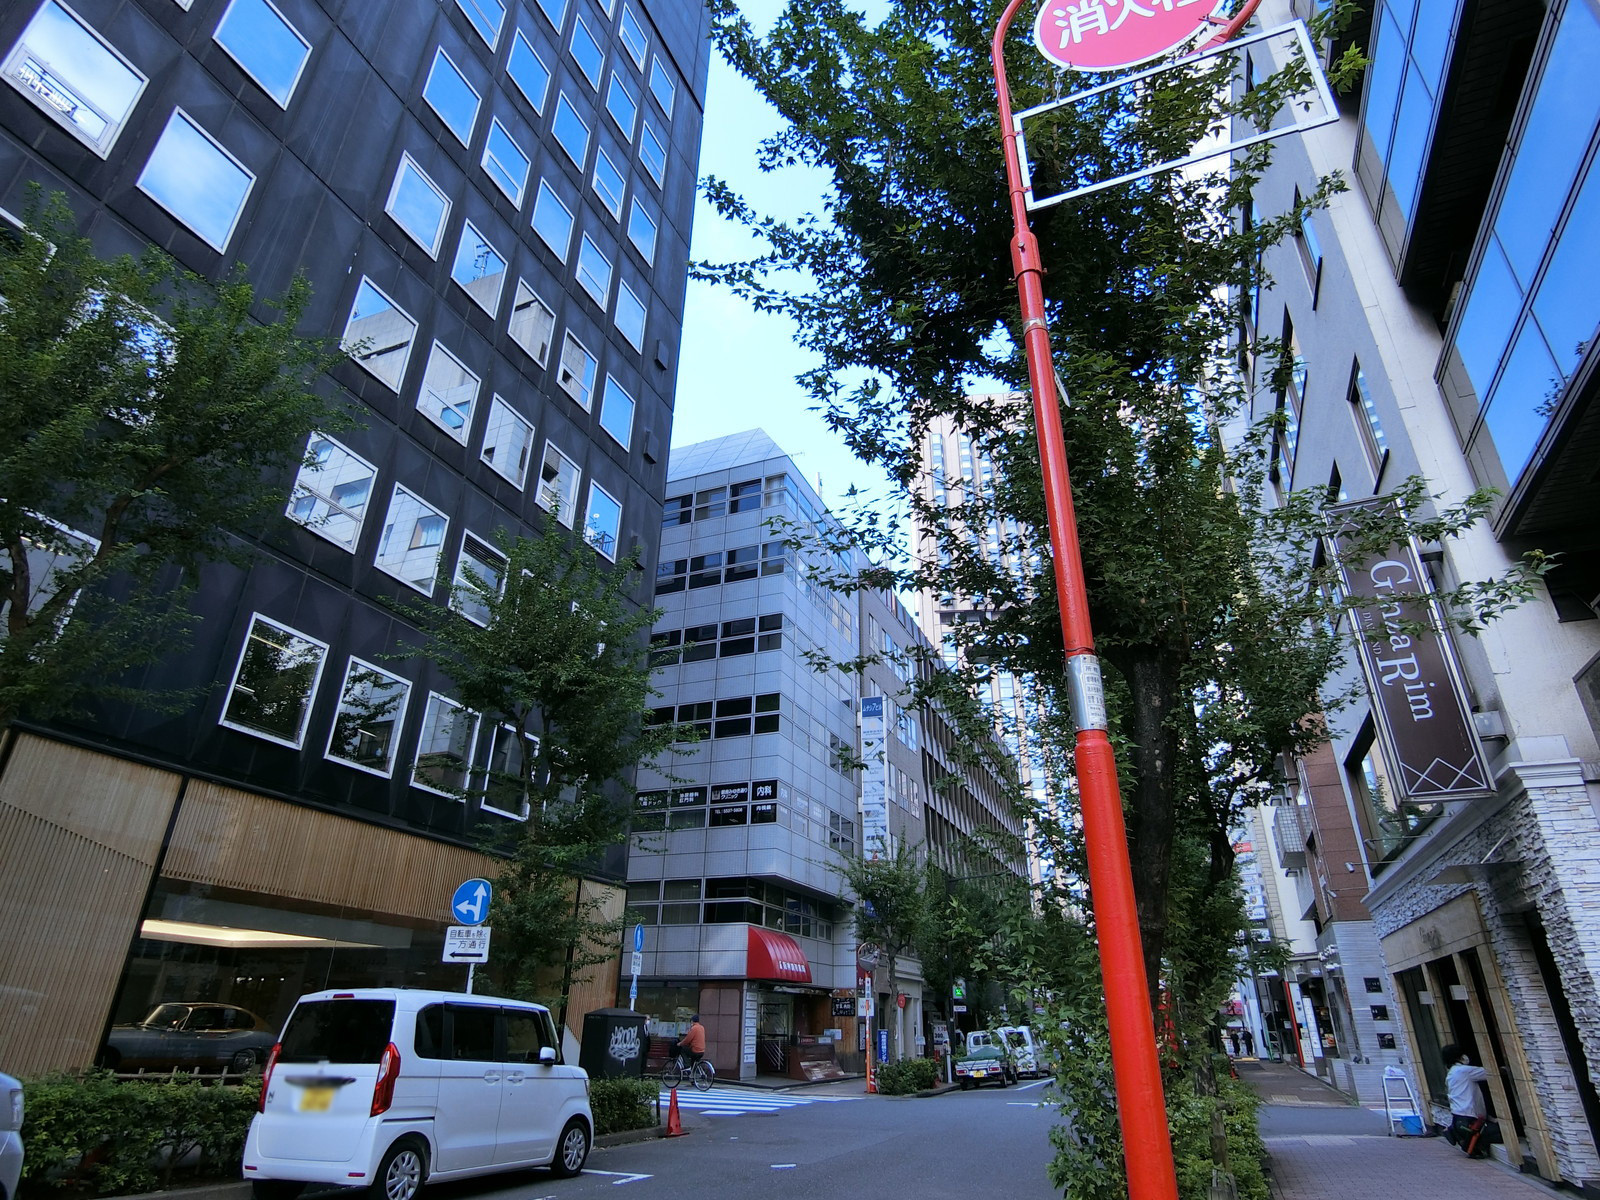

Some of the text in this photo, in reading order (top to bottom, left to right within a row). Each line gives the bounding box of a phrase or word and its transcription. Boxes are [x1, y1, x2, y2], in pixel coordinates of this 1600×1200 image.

[756, 785, 772, 797] 内科
[449, 929, 487, 939] 自転車を除く
[448, 940, 487, 950] 一方通行
